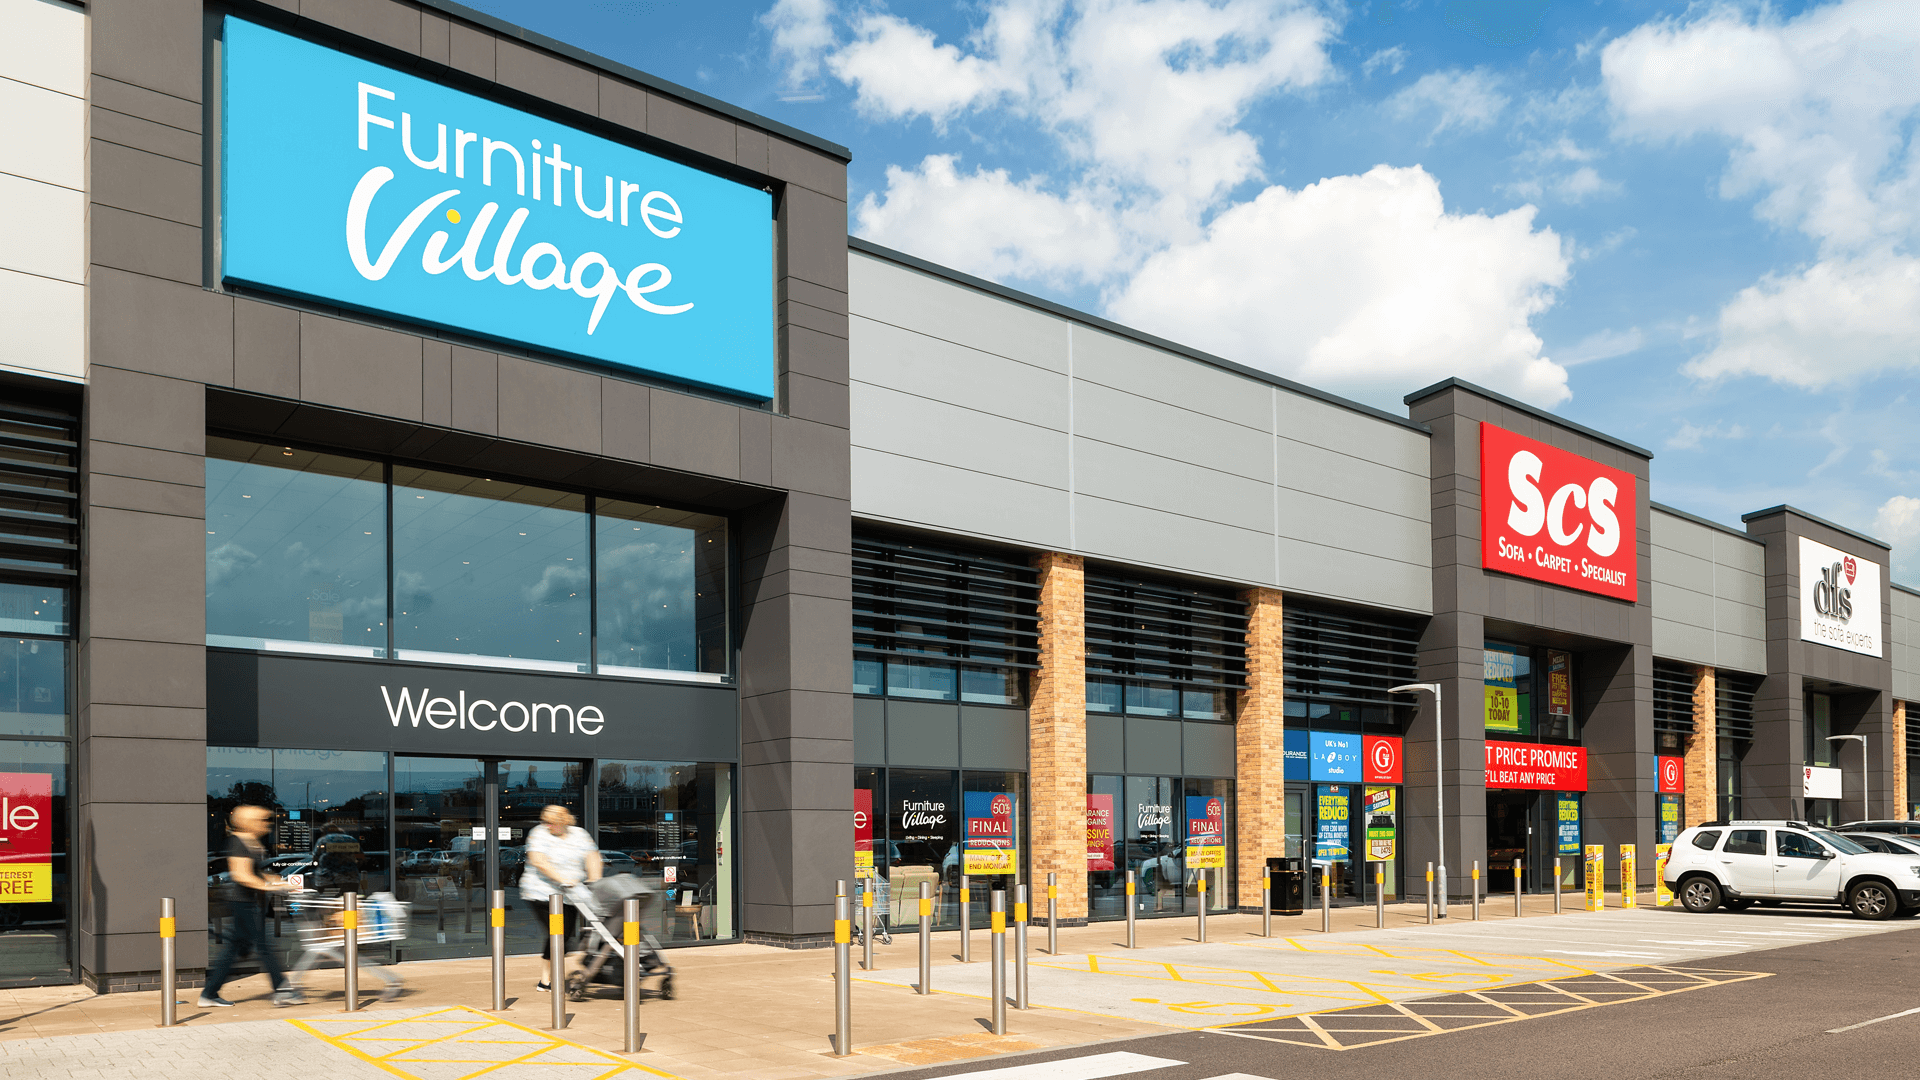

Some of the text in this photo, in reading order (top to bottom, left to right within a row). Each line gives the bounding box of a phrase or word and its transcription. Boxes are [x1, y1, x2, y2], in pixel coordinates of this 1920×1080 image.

[357, 82, 683, 239] Furniture
[346, 166, 694, 335] Village
[1507, 450, 1620, 557] ScS
[1813, 561, 1853, 621] dfs
[1814, 619, 1873, 650] the sofa experts
[380, 685, 604, 736] Welcome
[1488, 708, 1510, 722] TODAY
[1325, 740, 1336, 748] UK's
[1496, 747, 1528, 767] PRICE
[1530, 749, 1578, 769] PROMISE
[1328, 766, 1345, 775] studio
[1500, 771, 1518, 784] BEAT
[1519, 772, 1535, 784] ANY
[1536, 773, 1555, 785] PRICE
[1372, 790, 1389, 803] MEGA
[903, 800, 945, 811] Furniture
[1138, 804, 1170, 813] Furniture
[1087, 809, 1110, 817] RANCE
[1319, 806, 1348, 820] REDUCED
[902, 811, 947, 830] Village
[972, 821, 1008, 833] FINAL
[1137, 813, 1171, 829] Village
[1192, 821, 1219, 832] FINAL
